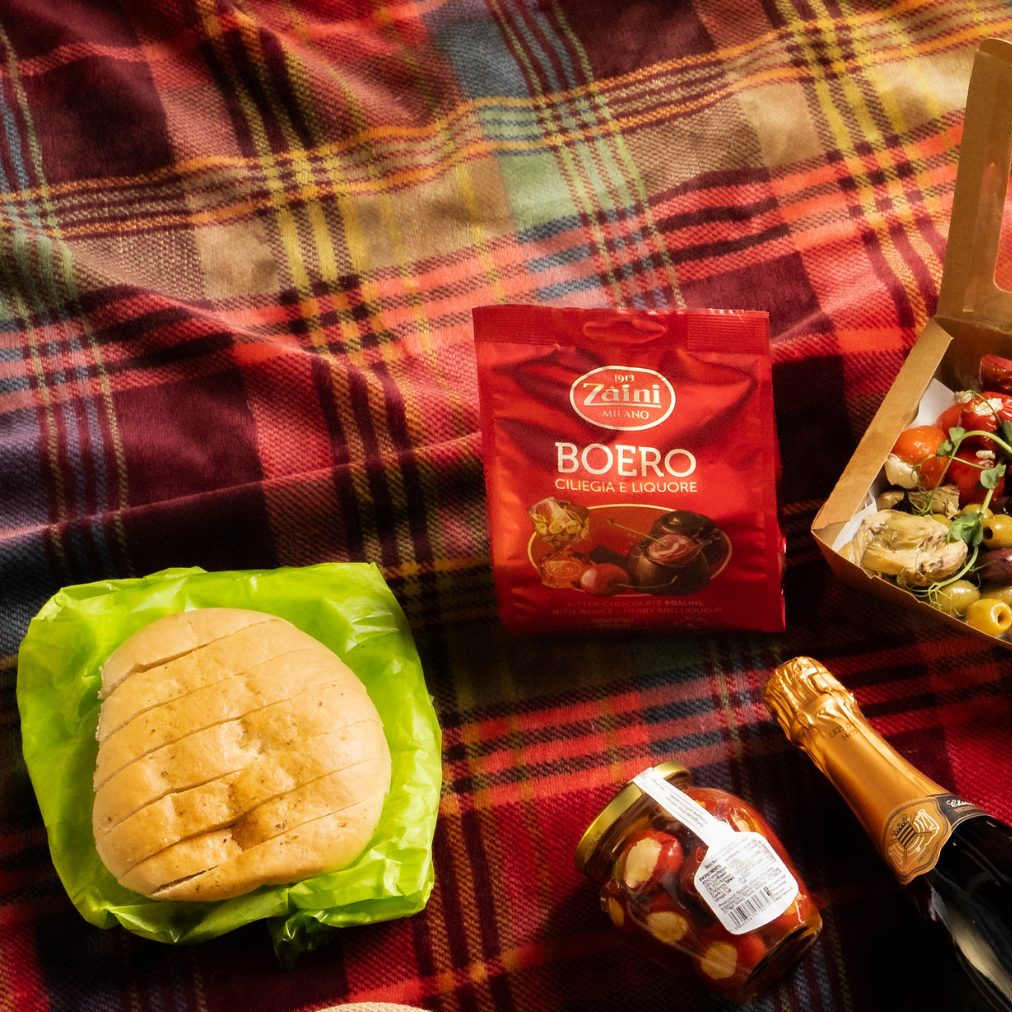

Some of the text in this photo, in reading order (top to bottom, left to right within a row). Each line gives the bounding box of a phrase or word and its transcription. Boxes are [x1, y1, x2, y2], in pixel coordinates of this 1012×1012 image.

[614, 374, 635, 383] 1913
[602, 409, 650, 420] MILANO
[555, 441, 697, 478] BOERO
[555, 478, 698, 493] CILIEGIA E LIQUORE
[602, 600, 662, 608] CHOCOLATE
[680, 606, 723, 614] LIQUEUR
